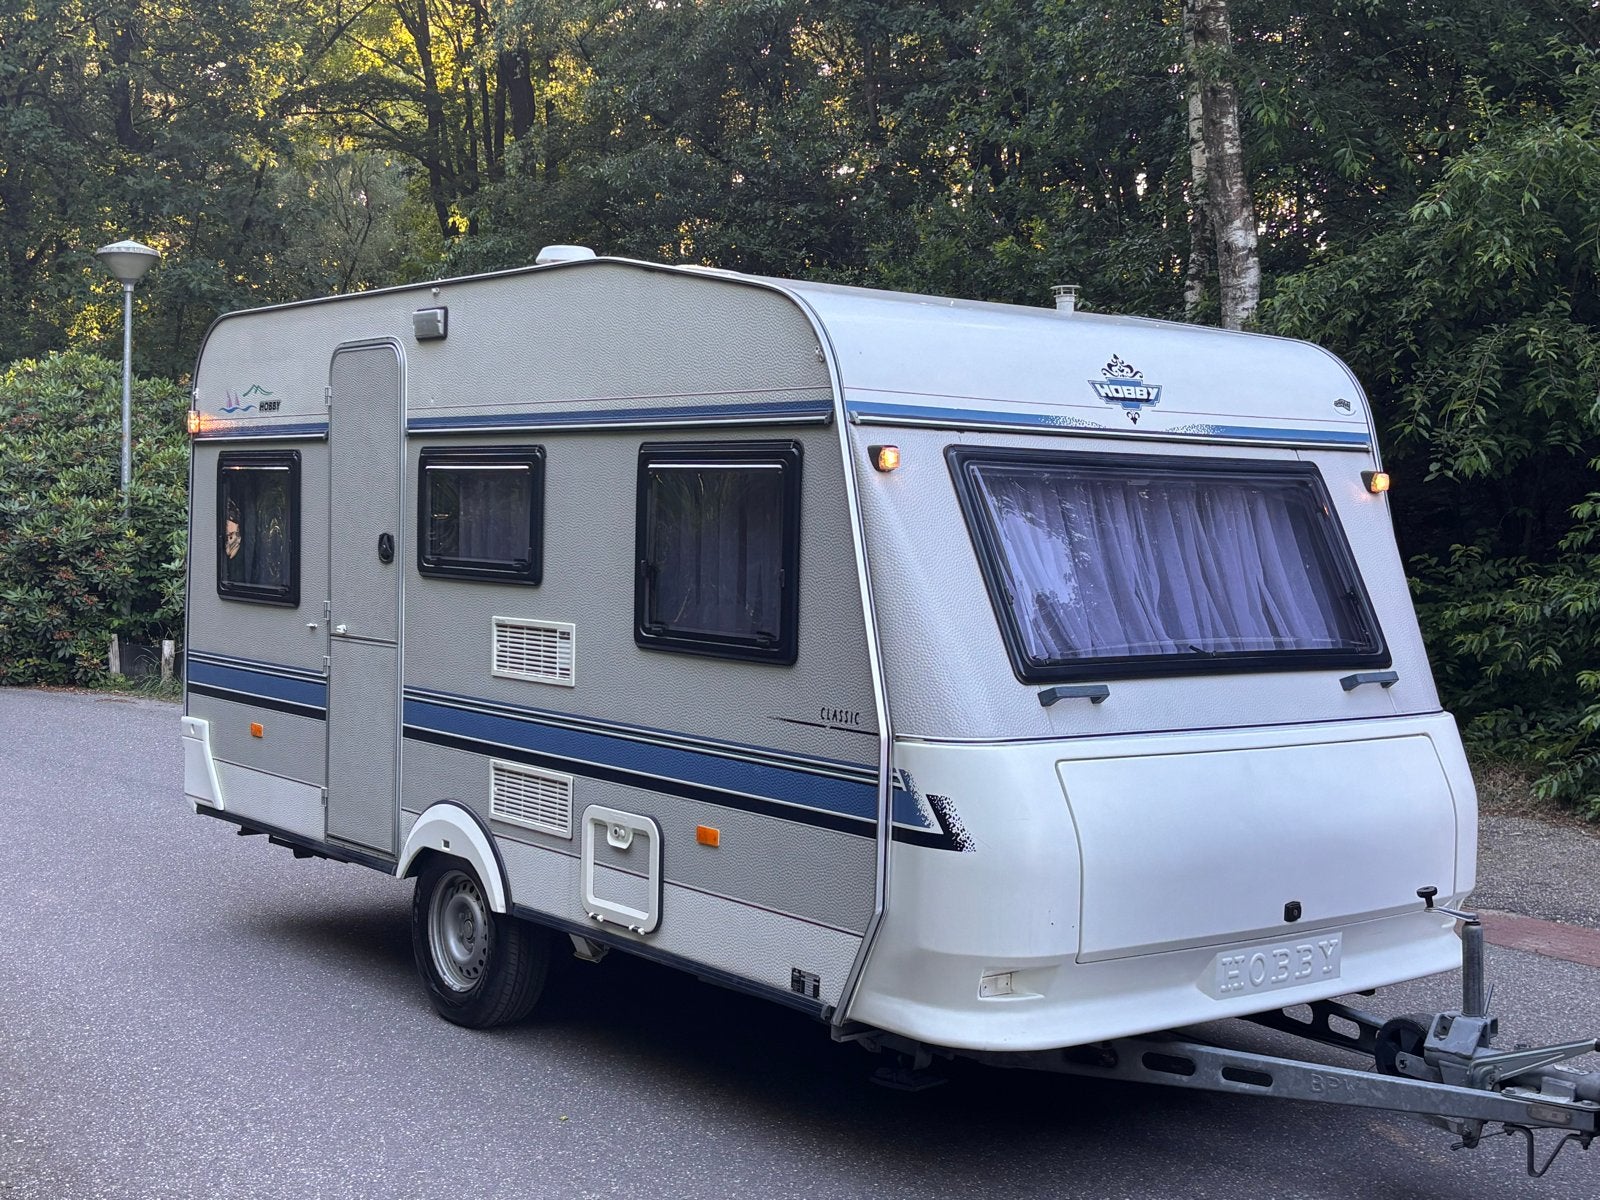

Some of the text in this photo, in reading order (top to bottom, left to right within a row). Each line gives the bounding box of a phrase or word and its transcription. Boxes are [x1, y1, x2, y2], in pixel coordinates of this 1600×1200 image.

[1094, 383, 1159, 401] HOBBY
[259, 401, 281, 412] HOBBY
[820, 707, 860, 726] CLASSIC
[1220, 939, 1339, 993] HOBBY
